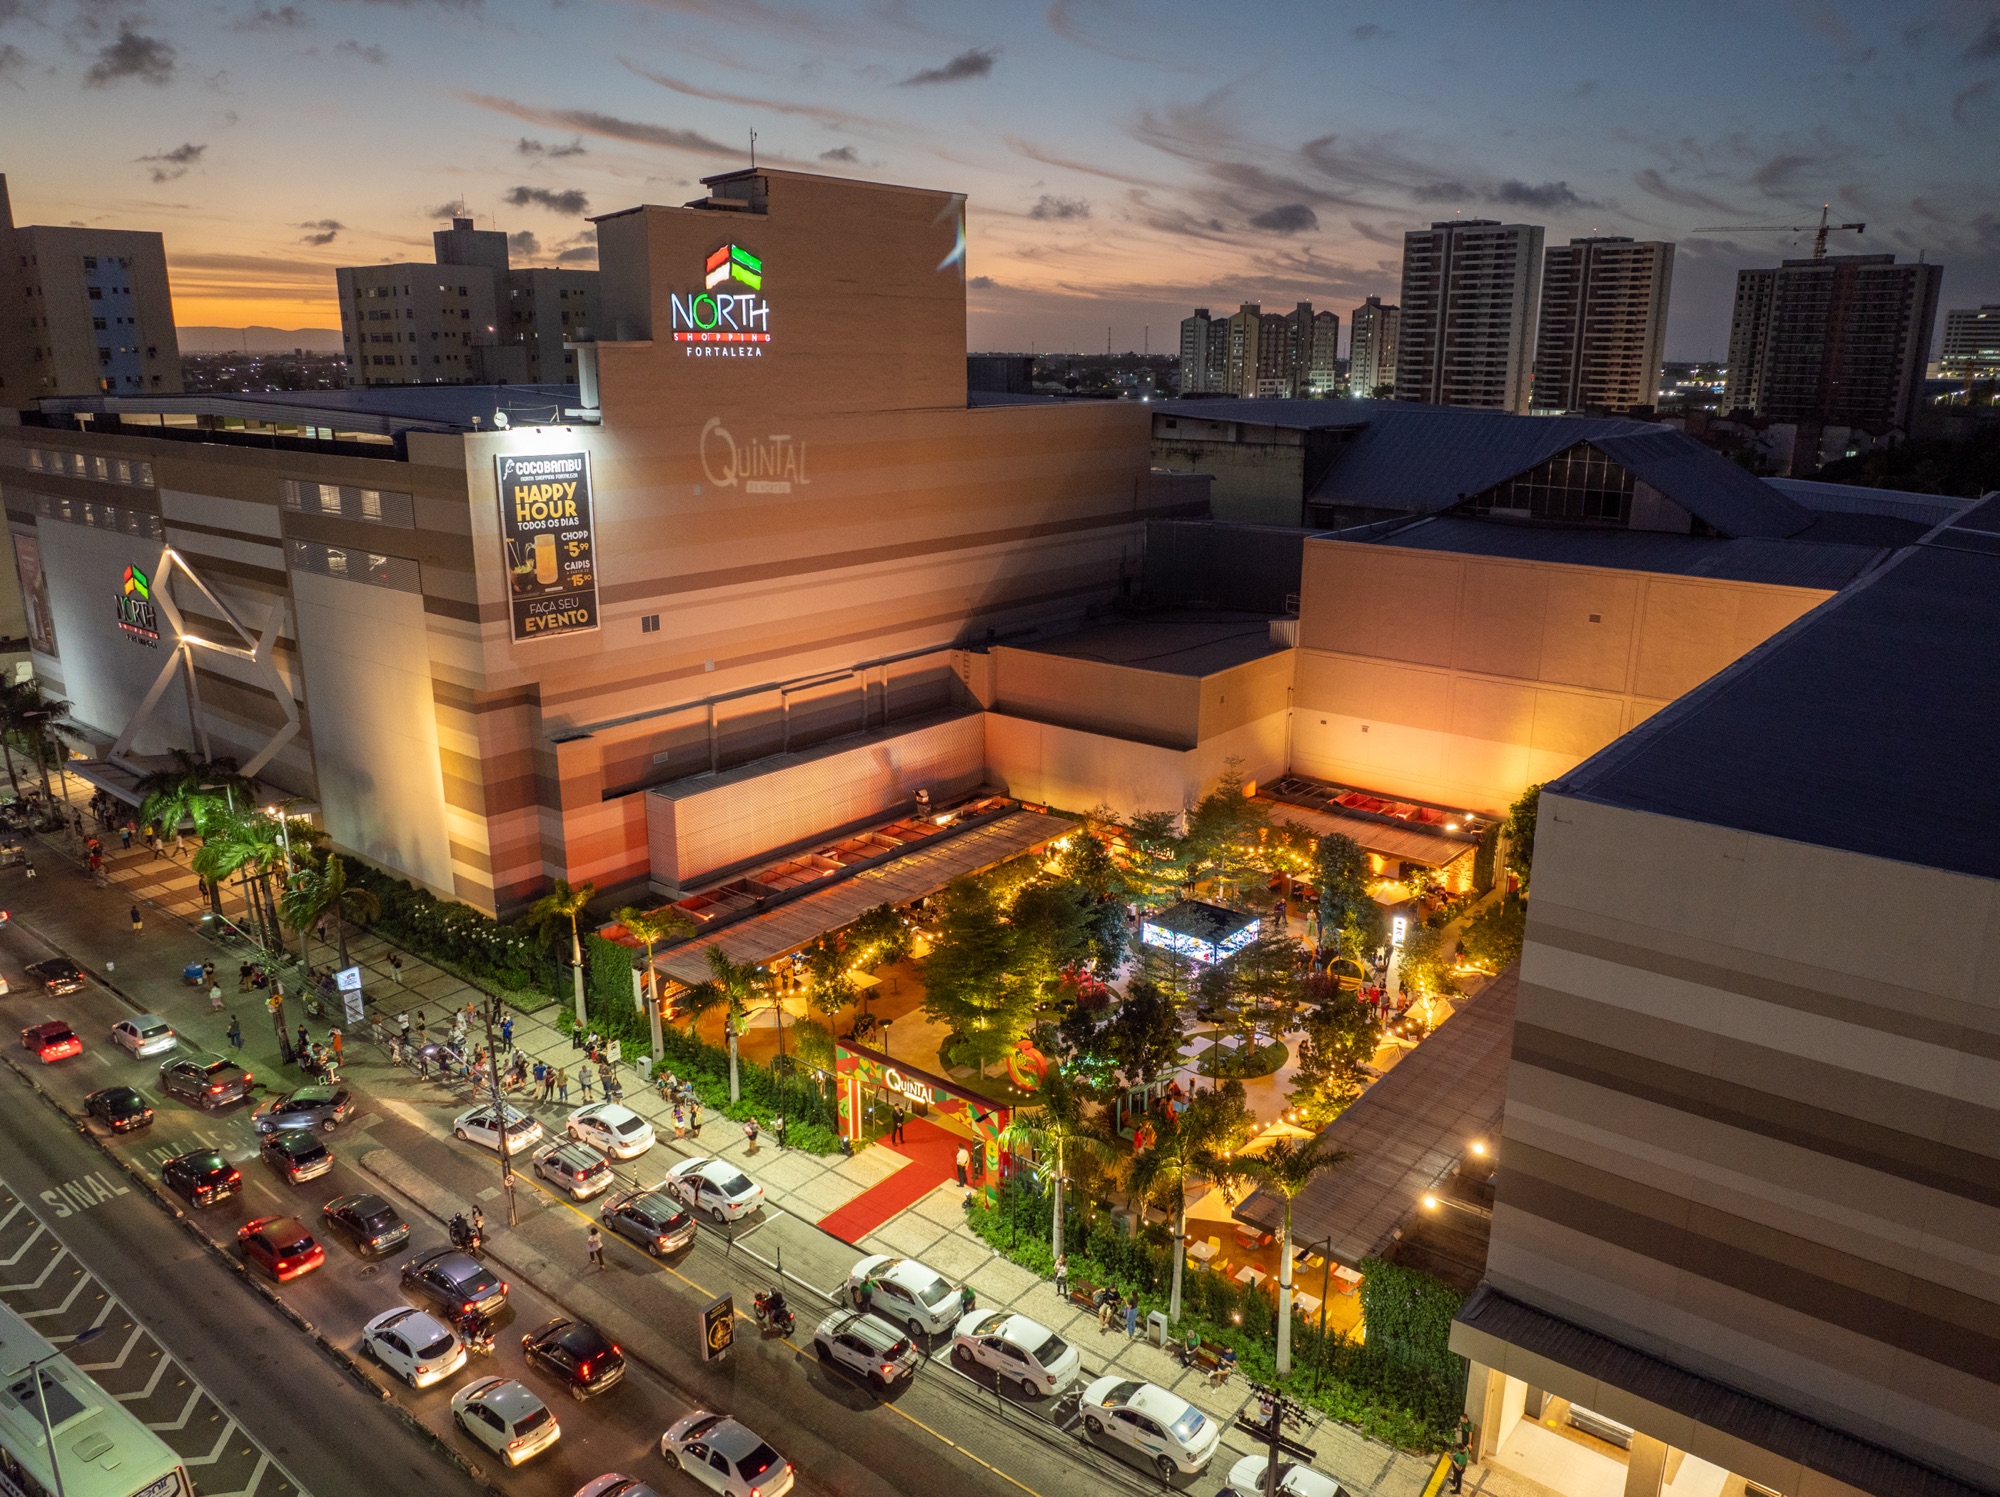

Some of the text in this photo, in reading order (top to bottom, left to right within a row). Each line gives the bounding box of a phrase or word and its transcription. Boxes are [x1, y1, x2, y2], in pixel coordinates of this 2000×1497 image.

[671, 293, 770, 331] NORTH
[673, 333, 771, 342] SHOPPING
[686, 346, 762, 357] FORTALEZA
[514, 482, 577, 504] HAPPY
[516, 500, 578, 522] HOUR
[517, 517, 580, 531] TODOS OS DIAS
[561, 530, 589, 541] CHOPP
[564, 559, 591, 571] CAIPIS
[114, 594, 157, 632] NORTH
[529, 597, 580, 615] FAÇA SEU
[525, 608, 589, 633] EVENTO
[39, 1171, 130, 1218] SINAL
